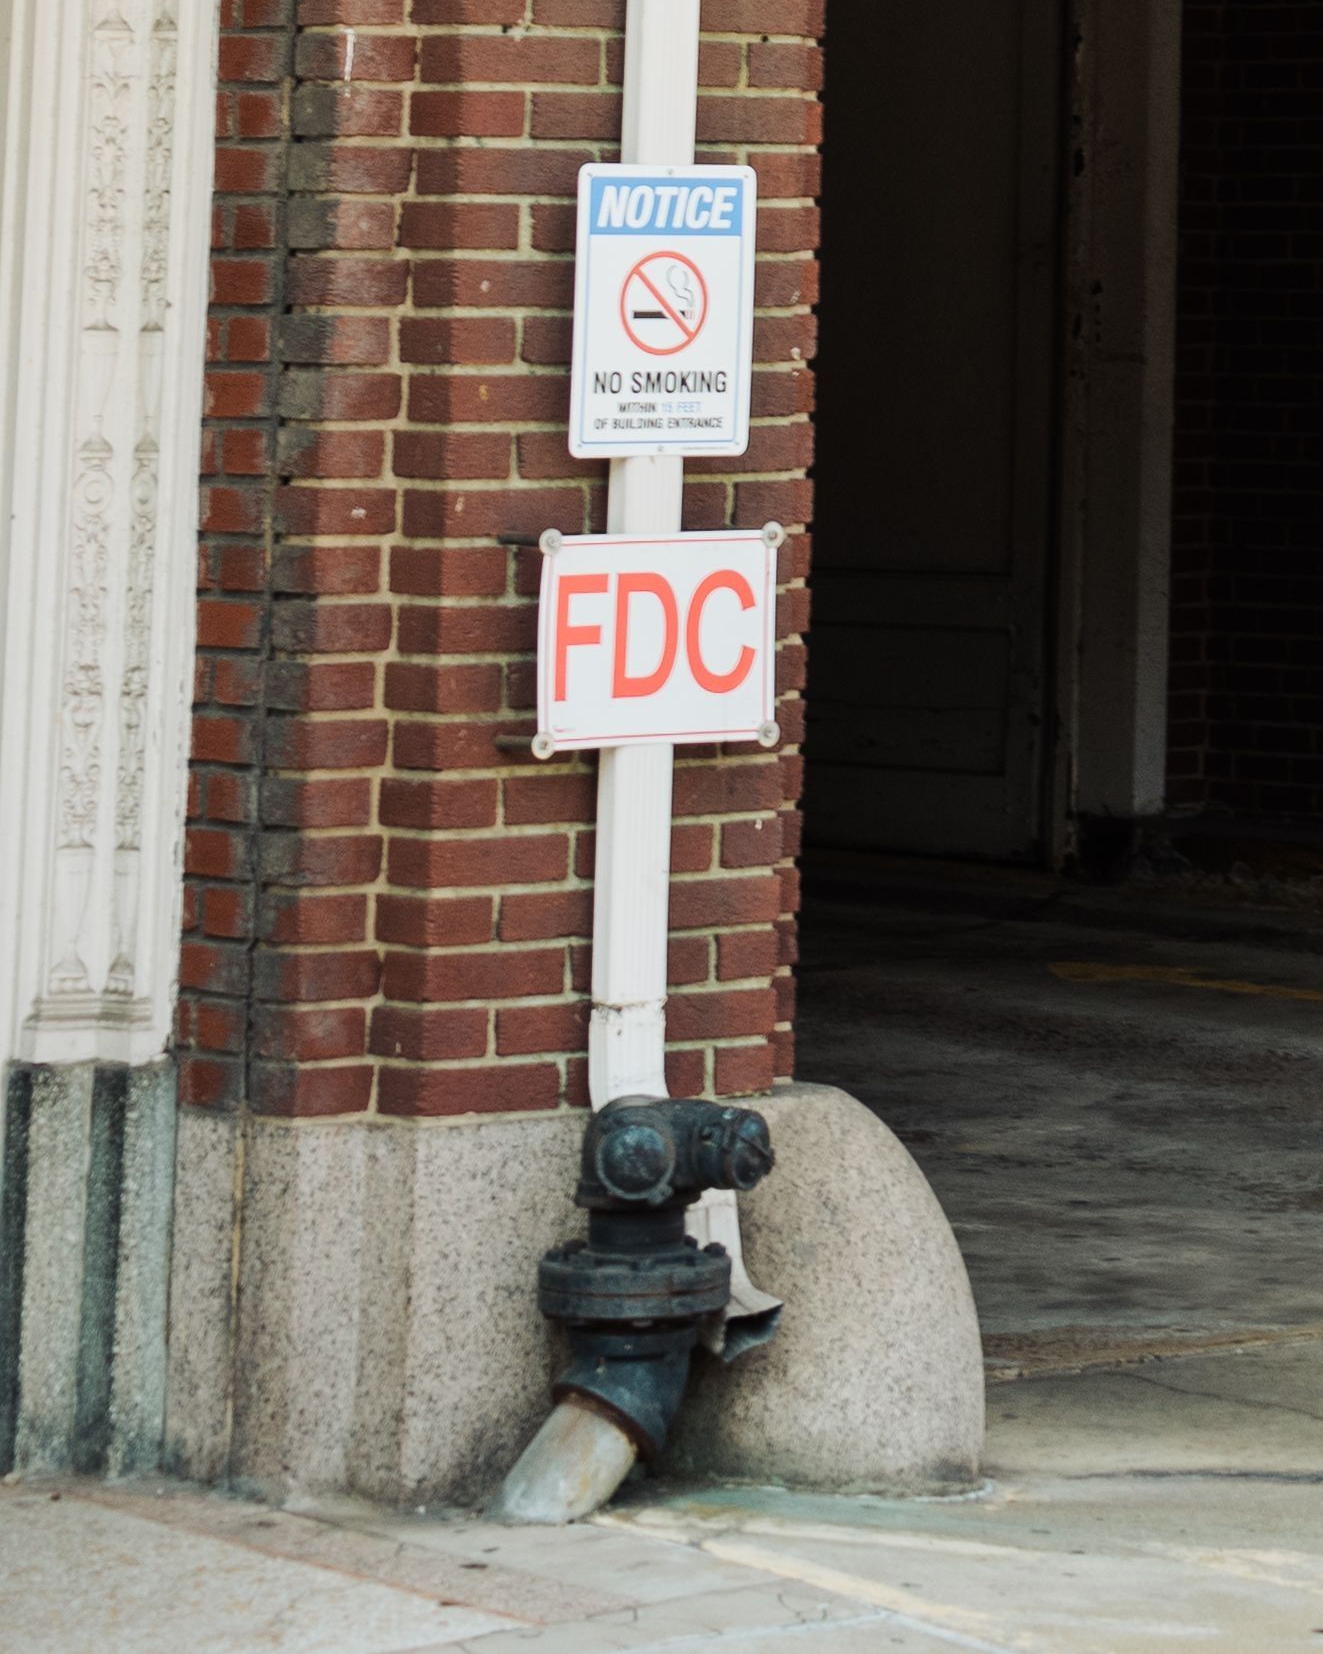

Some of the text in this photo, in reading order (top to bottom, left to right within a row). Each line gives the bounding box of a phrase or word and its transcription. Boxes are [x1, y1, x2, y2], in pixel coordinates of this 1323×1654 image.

[597, 185, 737, 229] NOTICE
[594, 371, 727, 394] NO SMOKING
[594, 417, 724, 430] OF BUILDING ENTRANCE
[553, 569, 757, 702] FDC
